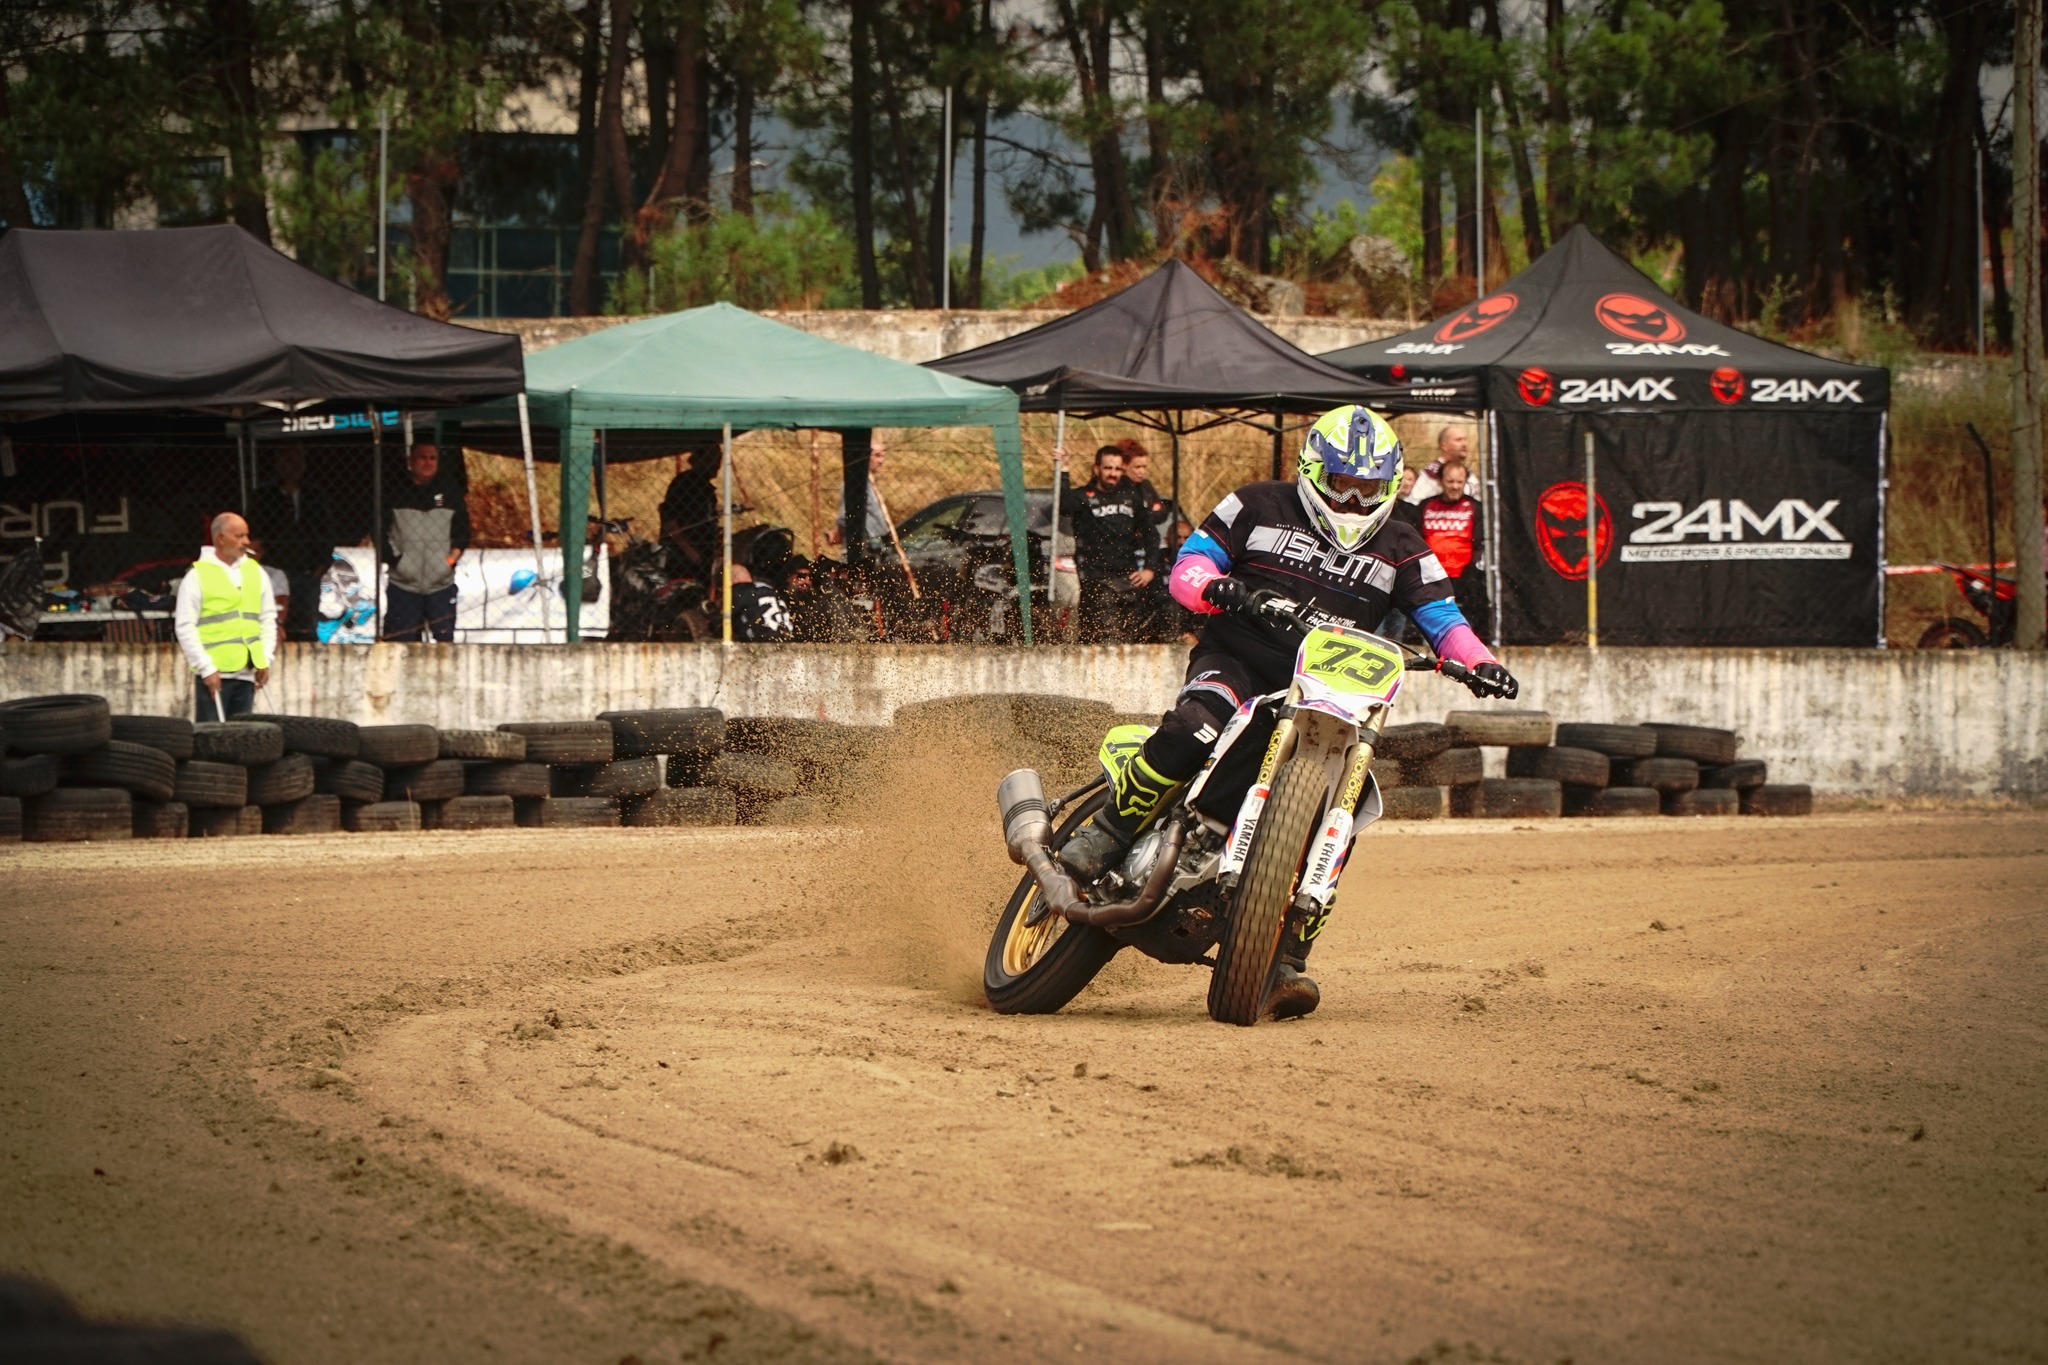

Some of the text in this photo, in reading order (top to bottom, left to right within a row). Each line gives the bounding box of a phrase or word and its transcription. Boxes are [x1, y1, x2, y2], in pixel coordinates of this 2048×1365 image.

[1605, 343, 1731, 357] 24MX
[1559, 377, 1678, 403] 24MX
[1751, 378, 1864, 403] 24MX
[1629, 498, 1845, 543] 24MX
[1282, 531, 1374, 580] SHOT
[1627, 548, 1720, 559] MOTOCROSS
[1734, 547, 1795, 558] ENDURO
[1309, 640, 1397, 687] 73
[1233, 818, 1257, 862] YAMAHA
[1309, 842, 1336, 886] YAMAHA
